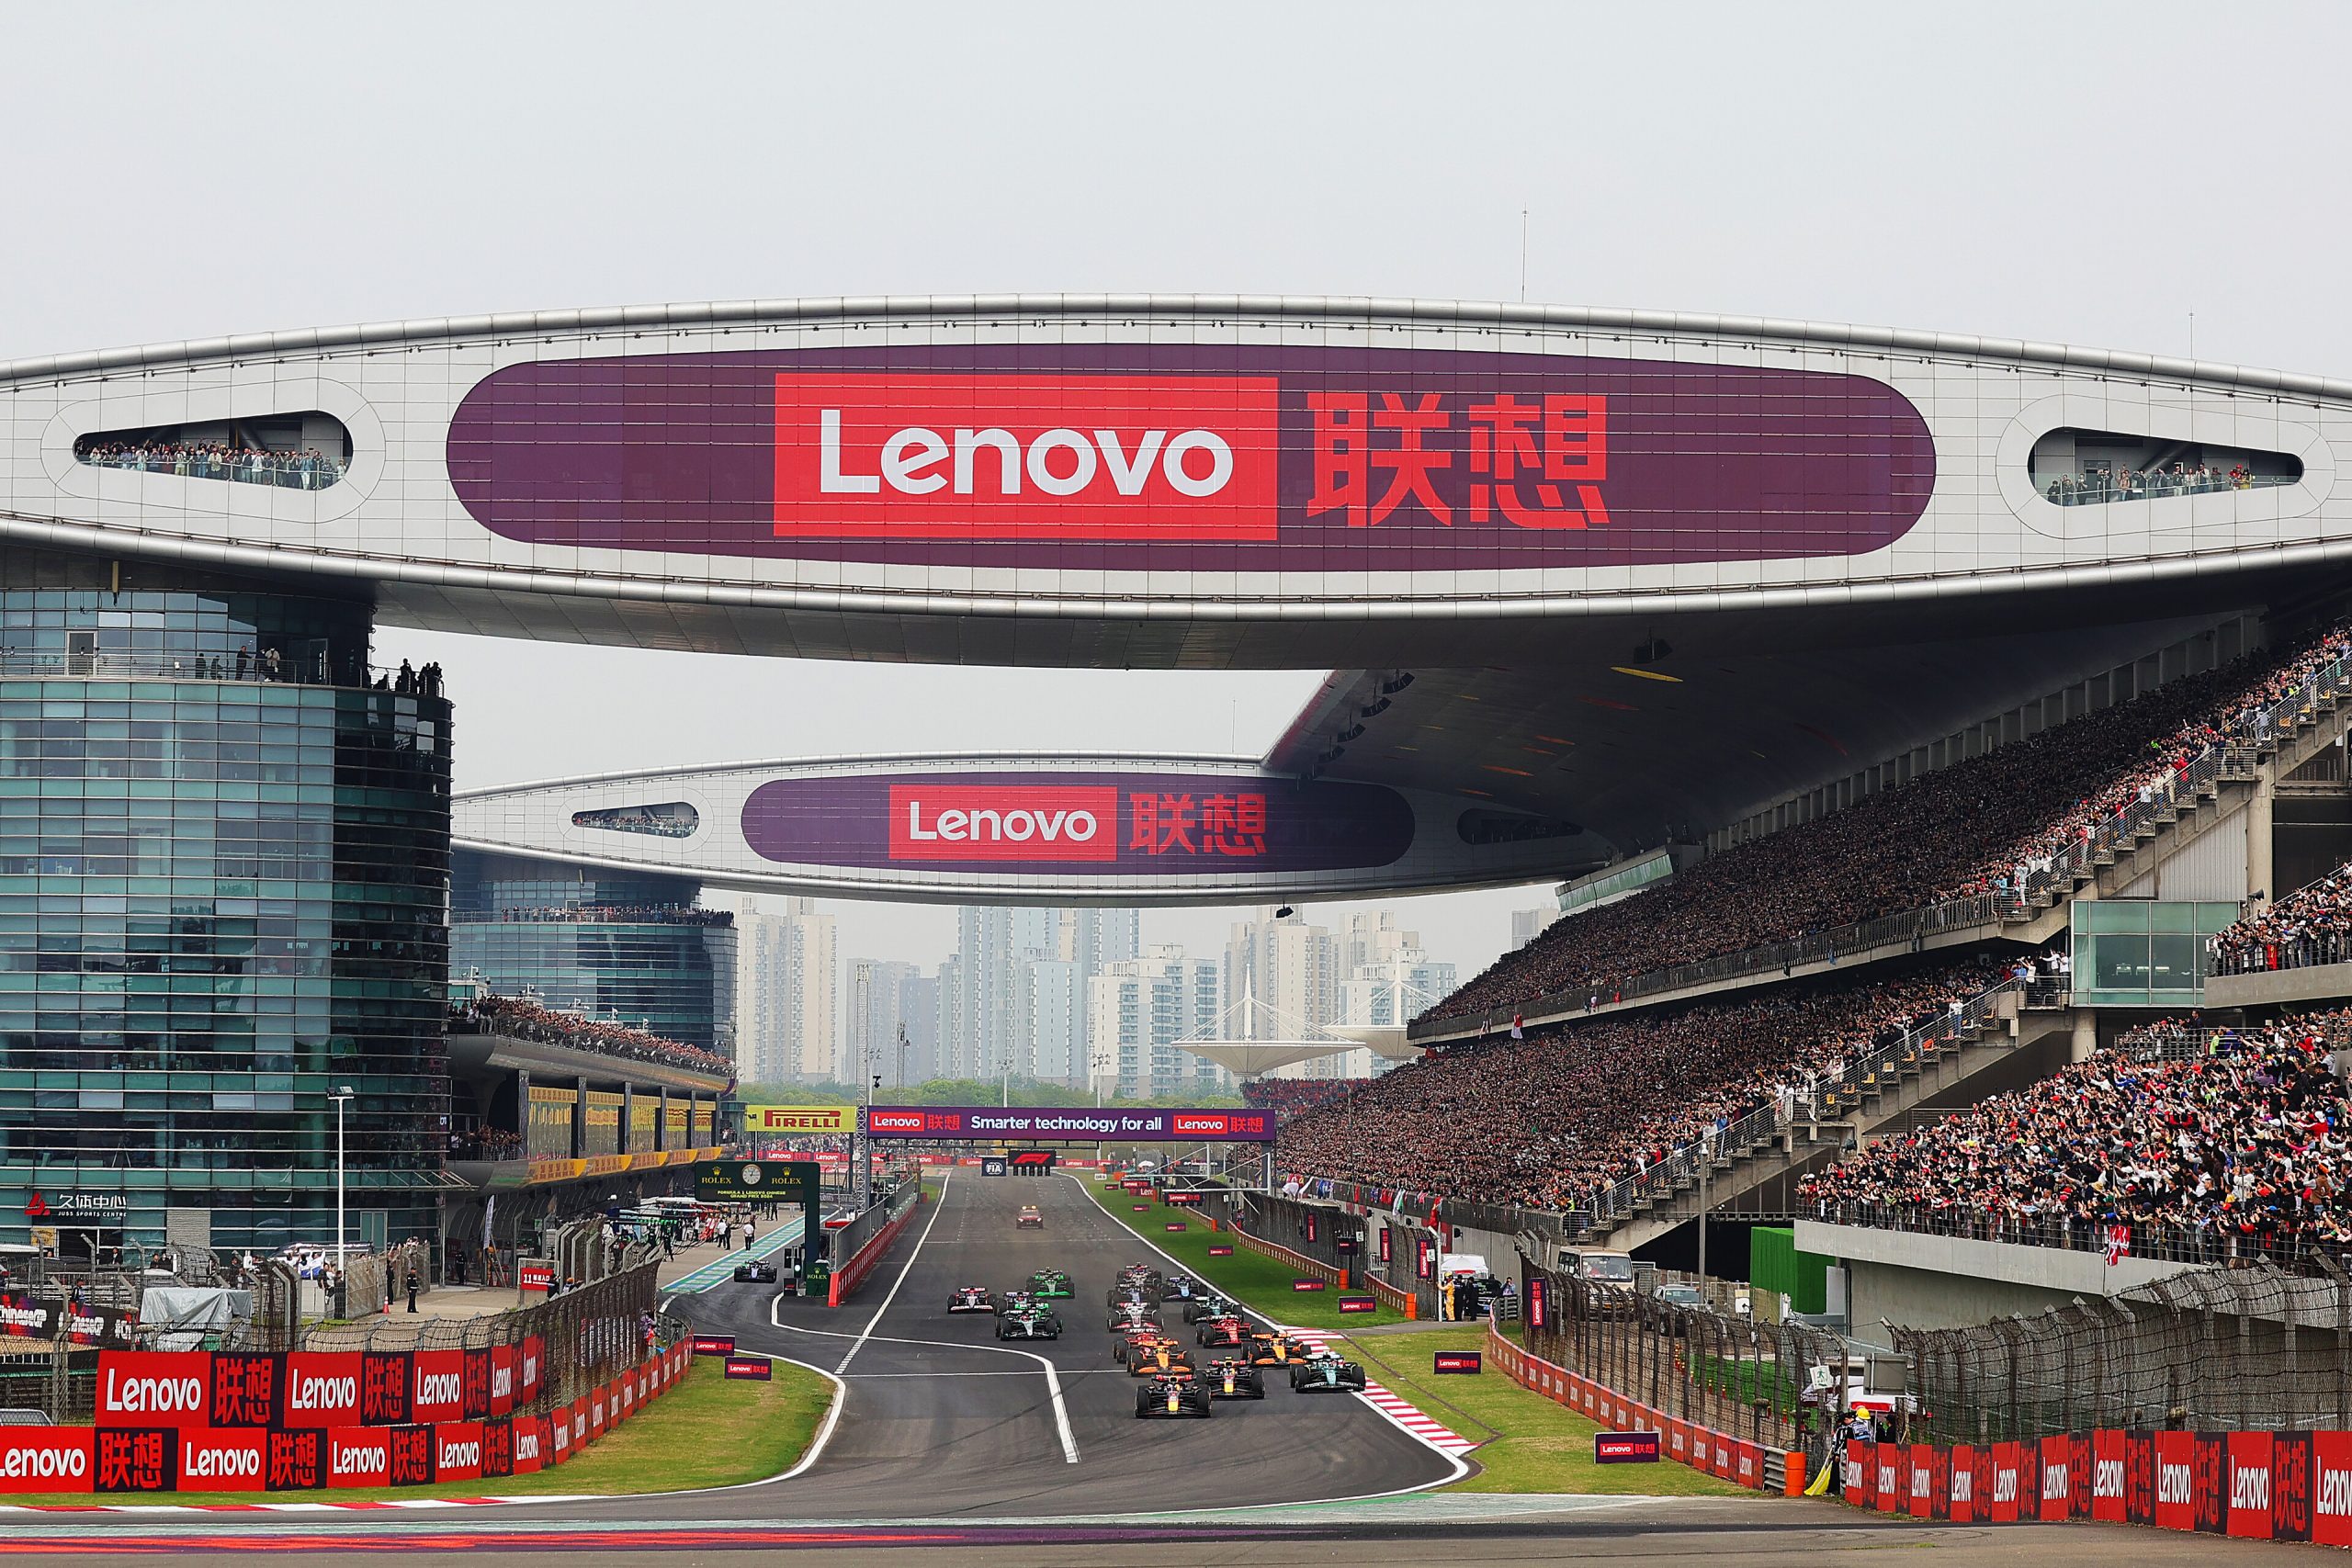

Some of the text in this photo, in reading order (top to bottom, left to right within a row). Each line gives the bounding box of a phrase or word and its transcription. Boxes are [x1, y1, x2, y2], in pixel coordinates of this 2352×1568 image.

[820, 391, 1610, 531] Lenovo 联想
[910, 793, 1267, 855] Lenovo 联想
[764, 1110, 841, 1128] PIRELLI
[875, 1114, 1263, 1133] Lenovo 联想 Smarter technology for all Lenovo 联想
[987, 1164, 1001, 1173] FIA
[58, 1193, 127, 1209] 久体中心
[523, 1273, 532, 1283] 11
[107, 1358, 274, 1424] Lenovo 联想
[291, 1358, 405, 1420] Lenovo 联想
[416, 1353, 488, 1415] Lenovo 联想
[492, 1361, 512, 1398] Lenovo
[99, 1432, 164, 1489] 联想
[186, 1432, 317, 1487] Lenovo 联想
[333, 1429, 427, 1483] Lenovo 联想
[439, 1424, 508, 1474] Lenovo 联想
[516, 1430, 538, 1461] Lenovo
[1739, 1450, 1752, 1477] Lenovo
[1846, 1452, 1862, 1489] Lenovo
[1879, 1457, 1895, 1495] Lenovo
[1912, 1461, 1930, 1498] Lenovo
[1951, 1461, 1972, 1502] Lenovo
[1994, 1461, 2017, 1502] Lenovo
[2043, 1456, 2067, 1500] Lenovo
[2093, 1450, 2124, 1498] Lenovo
[2157, 1452, 2191, 1505] Lenovo
[2231, 1440, 2306, 1532] Lenovo 联想
